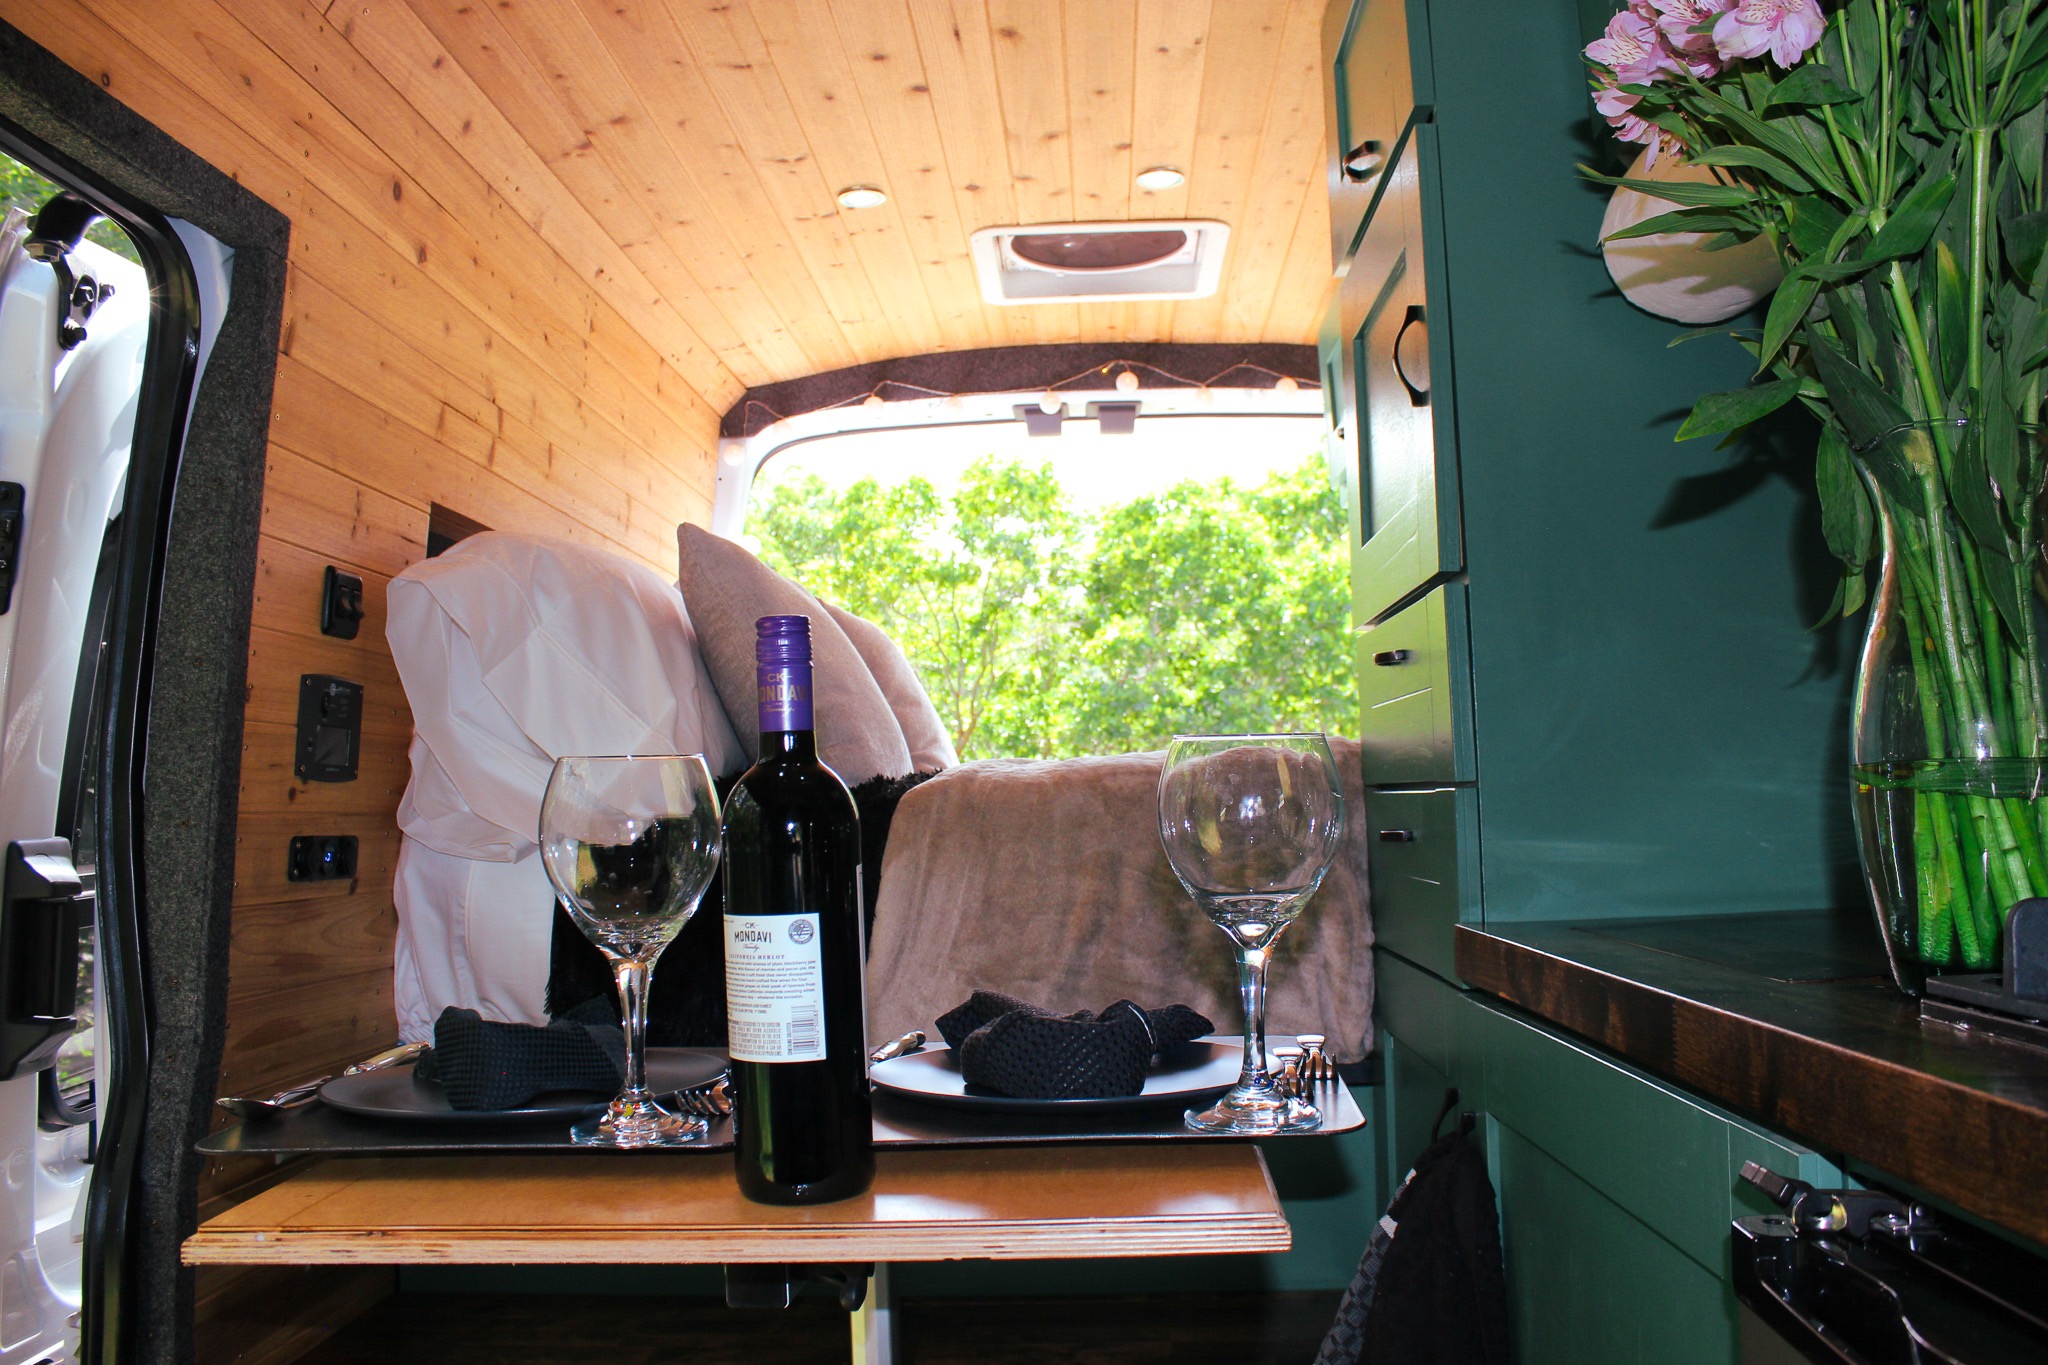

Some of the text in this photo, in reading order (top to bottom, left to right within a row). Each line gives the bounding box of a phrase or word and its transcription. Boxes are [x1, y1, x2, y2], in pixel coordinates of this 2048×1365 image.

[767, 673, 785, 682] CK
[734, 930, 772, 944] MONDAVI
[742, 944, 760, 953] Family
